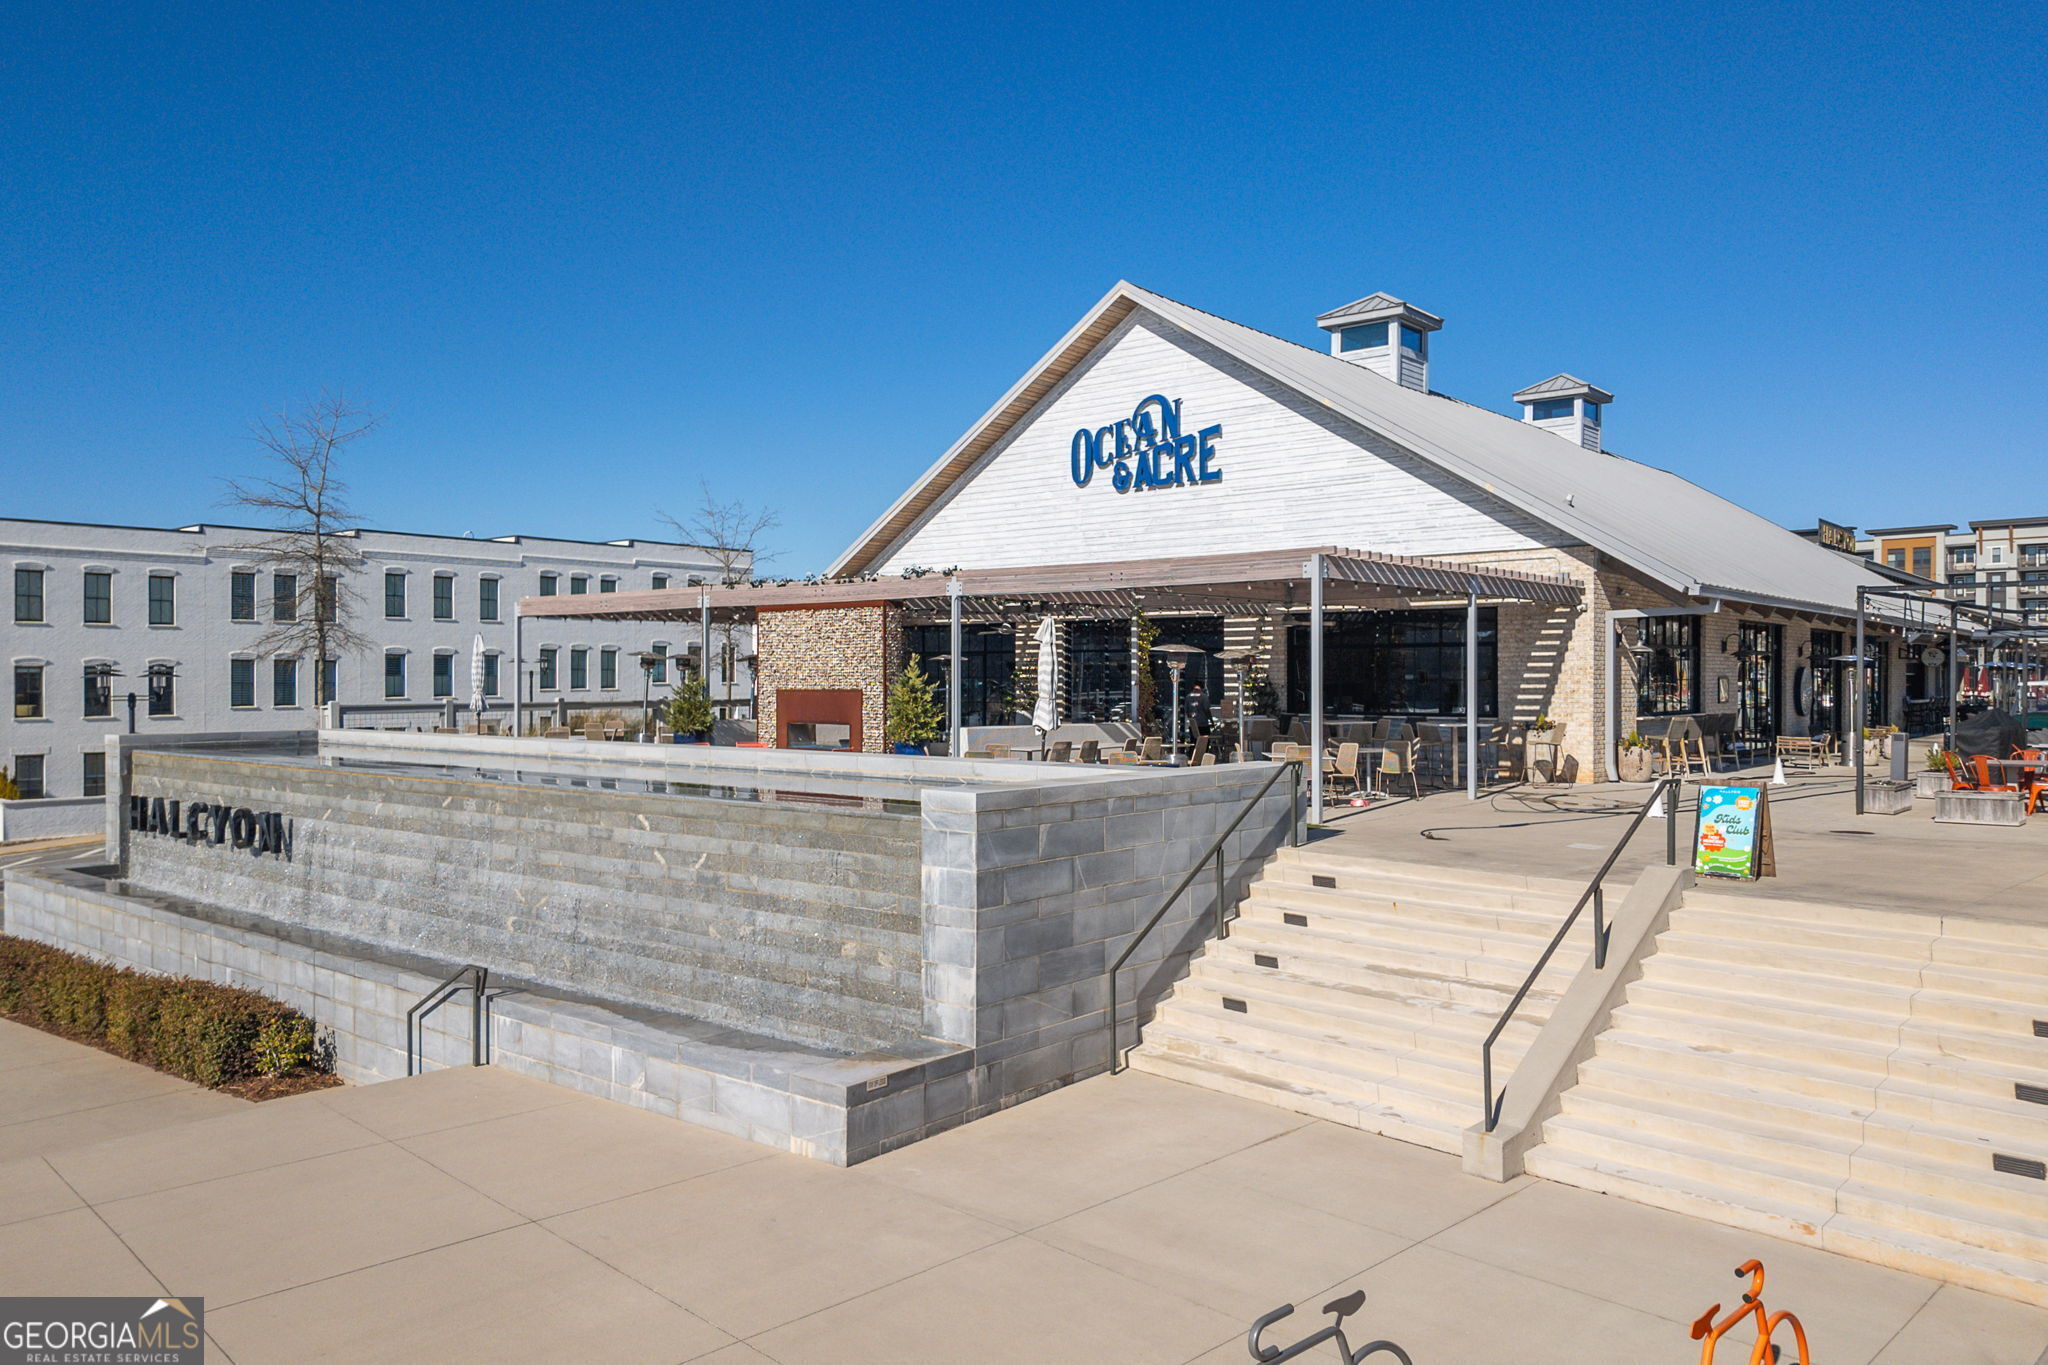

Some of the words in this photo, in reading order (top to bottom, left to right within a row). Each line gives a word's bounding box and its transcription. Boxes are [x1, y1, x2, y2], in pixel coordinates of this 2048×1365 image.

[1071, 394, 1183, 488] OCEAN
[1132, 424, 1222, 493] ACRE
[130, 795, 293, 862] HALCYON
[1713, 813, 1741, 824] Kids
[1725, 825, 1750, 836] Club
